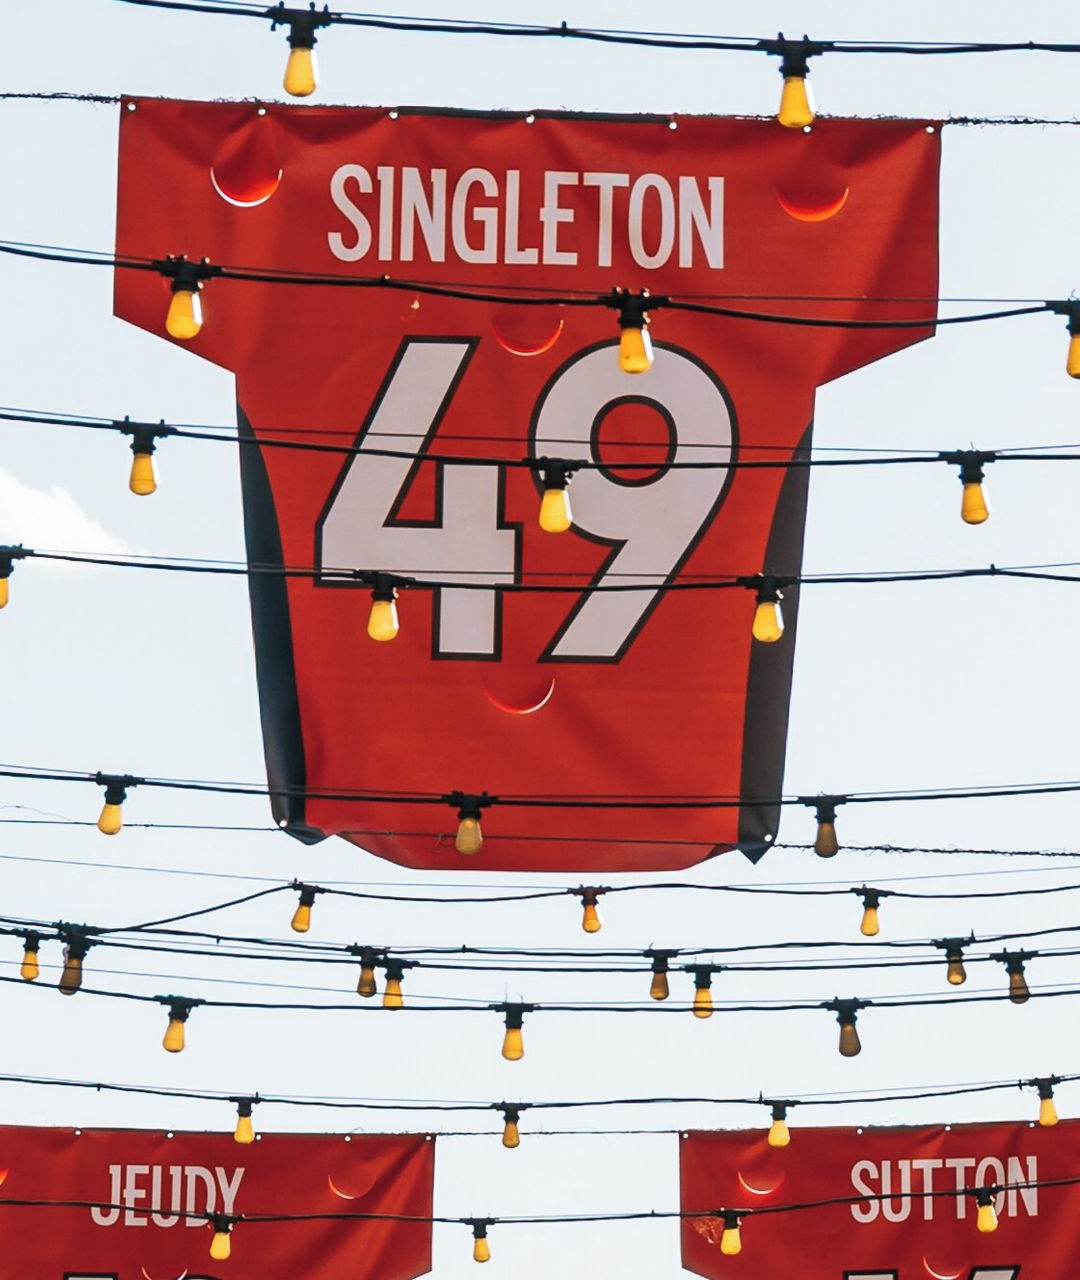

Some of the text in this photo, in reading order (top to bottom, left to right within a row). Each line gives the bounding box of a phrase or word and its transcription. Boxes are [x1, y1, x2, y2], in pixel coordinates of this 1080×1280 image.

[327, 163, 726, 270] SINGLETON
[315, 336, 738, 663] 49
[91, 1164, 246, 1228] JEUDY
[850, 1155, 1038, 1224] SUTTON
